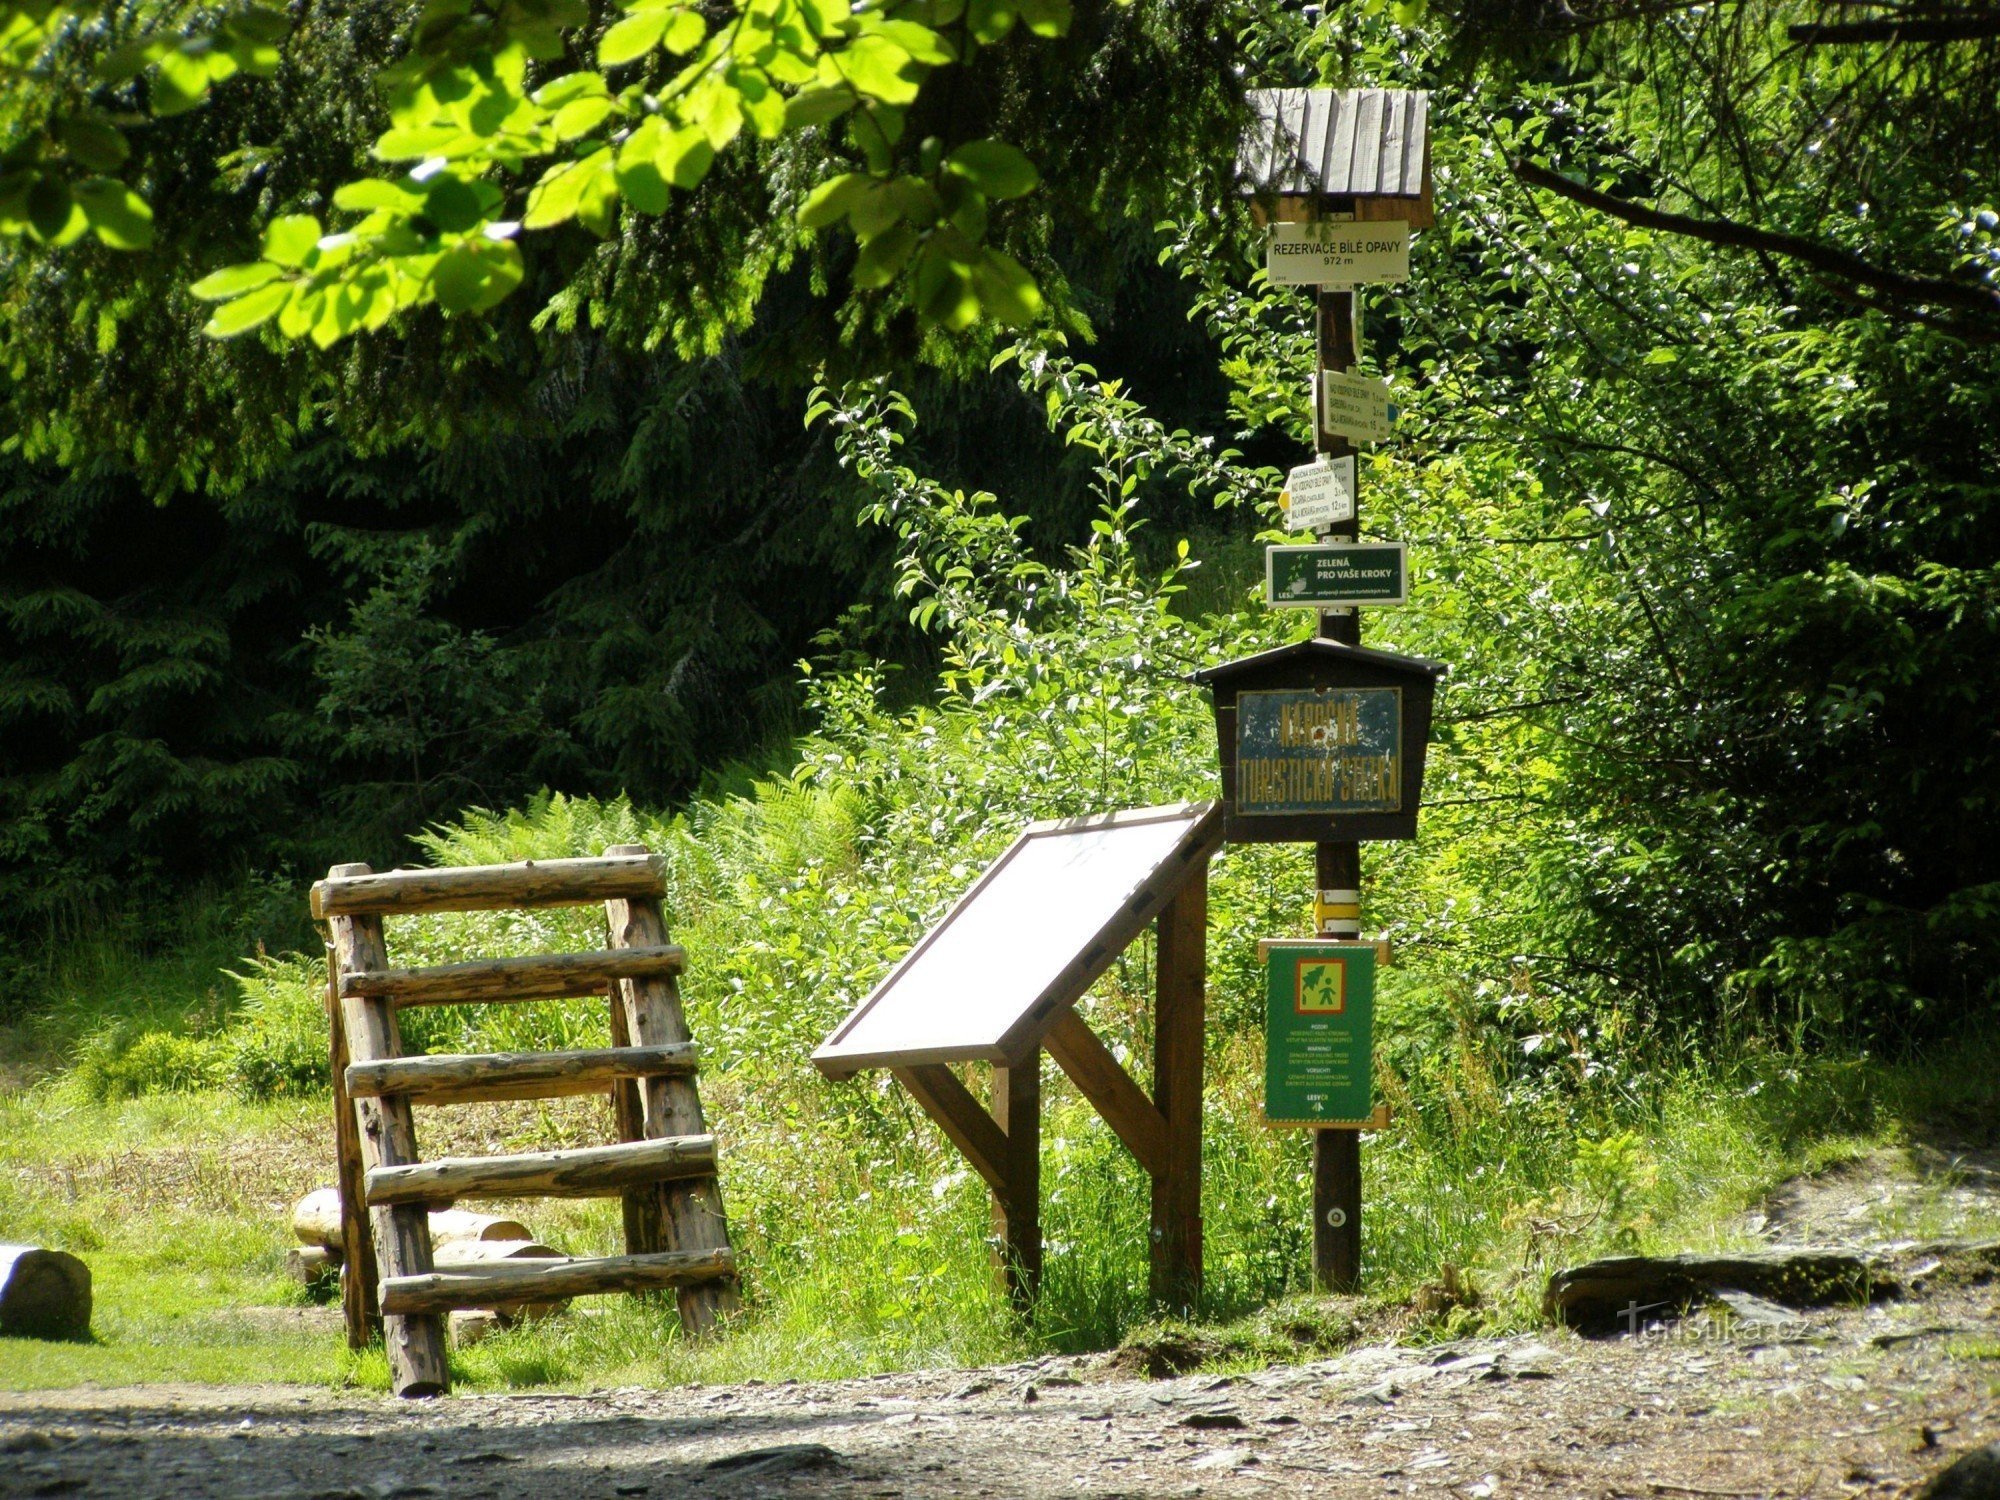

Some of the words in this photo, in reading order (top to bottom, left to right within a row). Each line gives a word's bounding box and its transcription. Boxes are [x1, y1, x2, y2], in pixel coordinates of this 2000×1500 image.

[1274, 242, 1336, 255] REZERVACE
[1339, 239, 1363, 254] BÍLÉ
[1366, 240, 1401, 253] OPAVY
[1323, 256, 1341, 265] 972
[1317, 557, 1350, 567] ZELENÁ
[1317, 571, 1335, 579] PRO
[1338, 569, 1359, 579] VAŠE
[1361, 569, 1392, 578] KROKY
[1341, 755, 1398, 802] STEZKA
